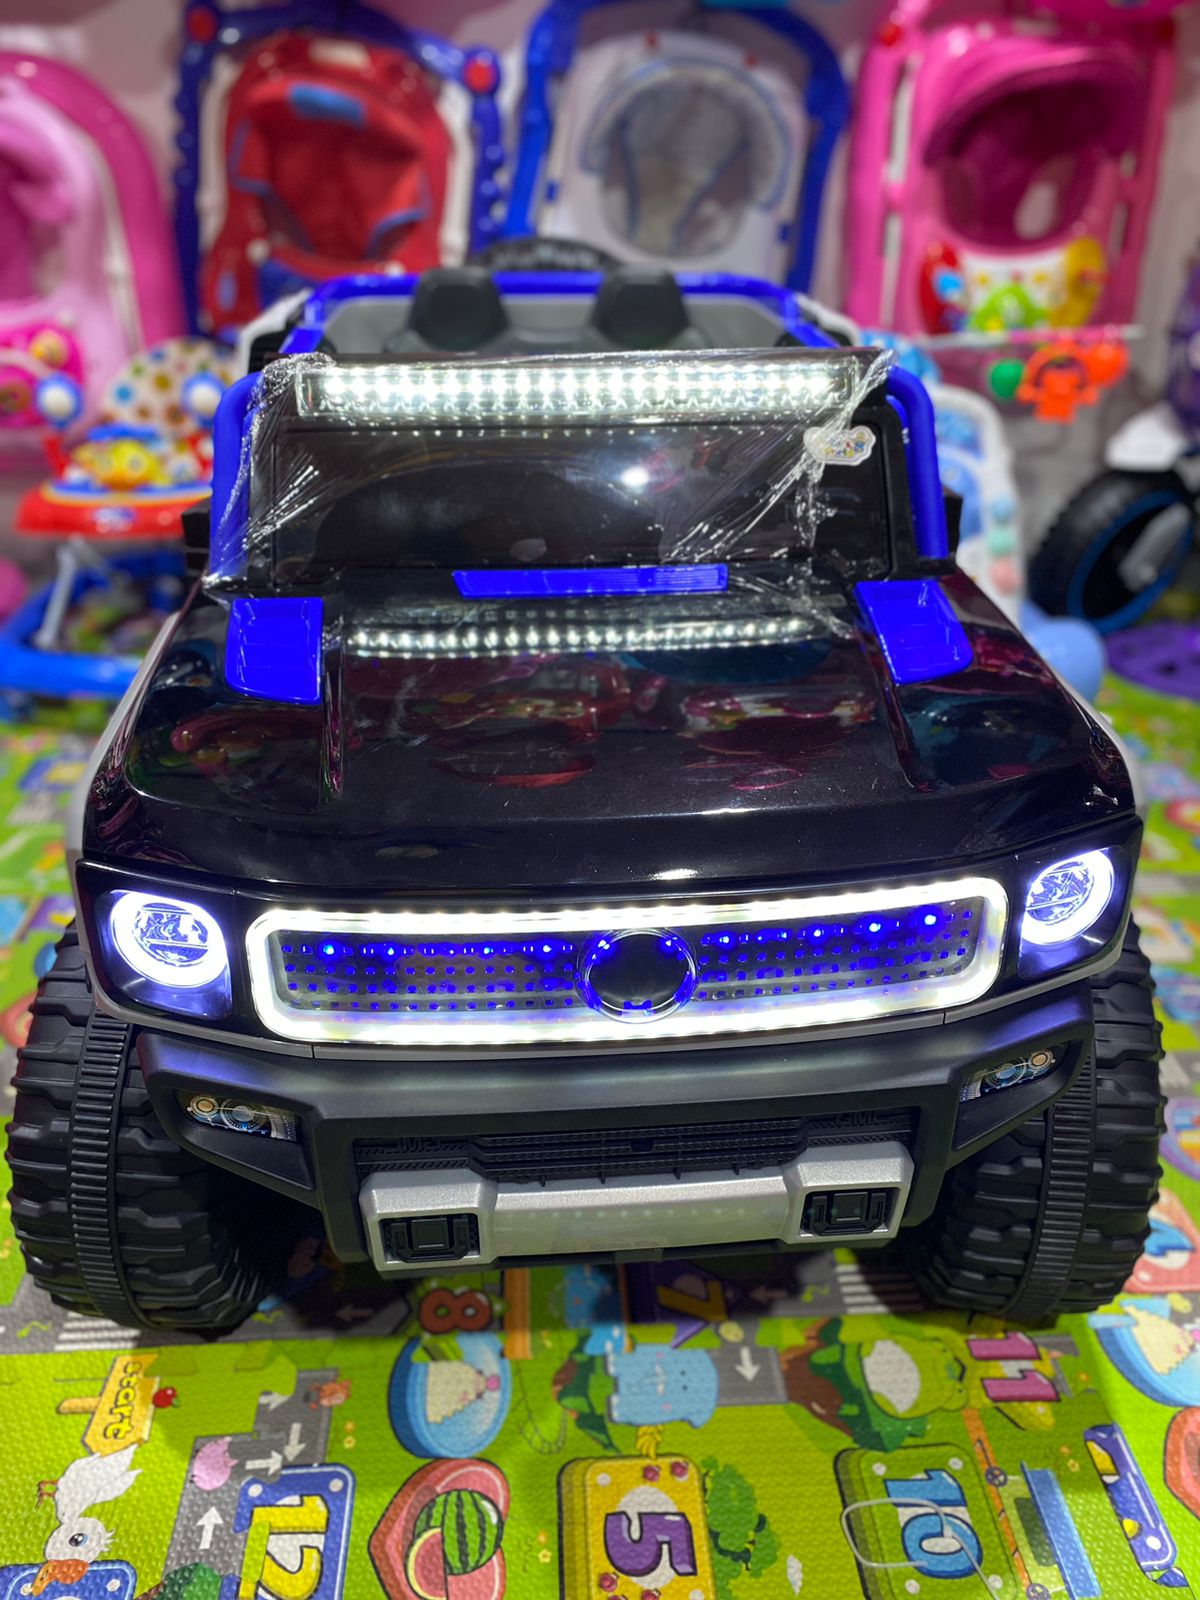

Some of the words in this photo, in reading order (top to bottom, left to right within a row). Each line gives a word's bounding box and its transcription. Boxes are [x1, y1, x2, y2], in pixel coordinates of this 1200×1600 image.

[419, 1287, 492, 1335] 8
[103, 1360, 142, 1439] start
[965, 1330, 1061, 1403] 11
[237, 1494, 330, 1600] 12
[604, 1511, 697, 1577] 5
[883, 1468, 984, 1580] 10
